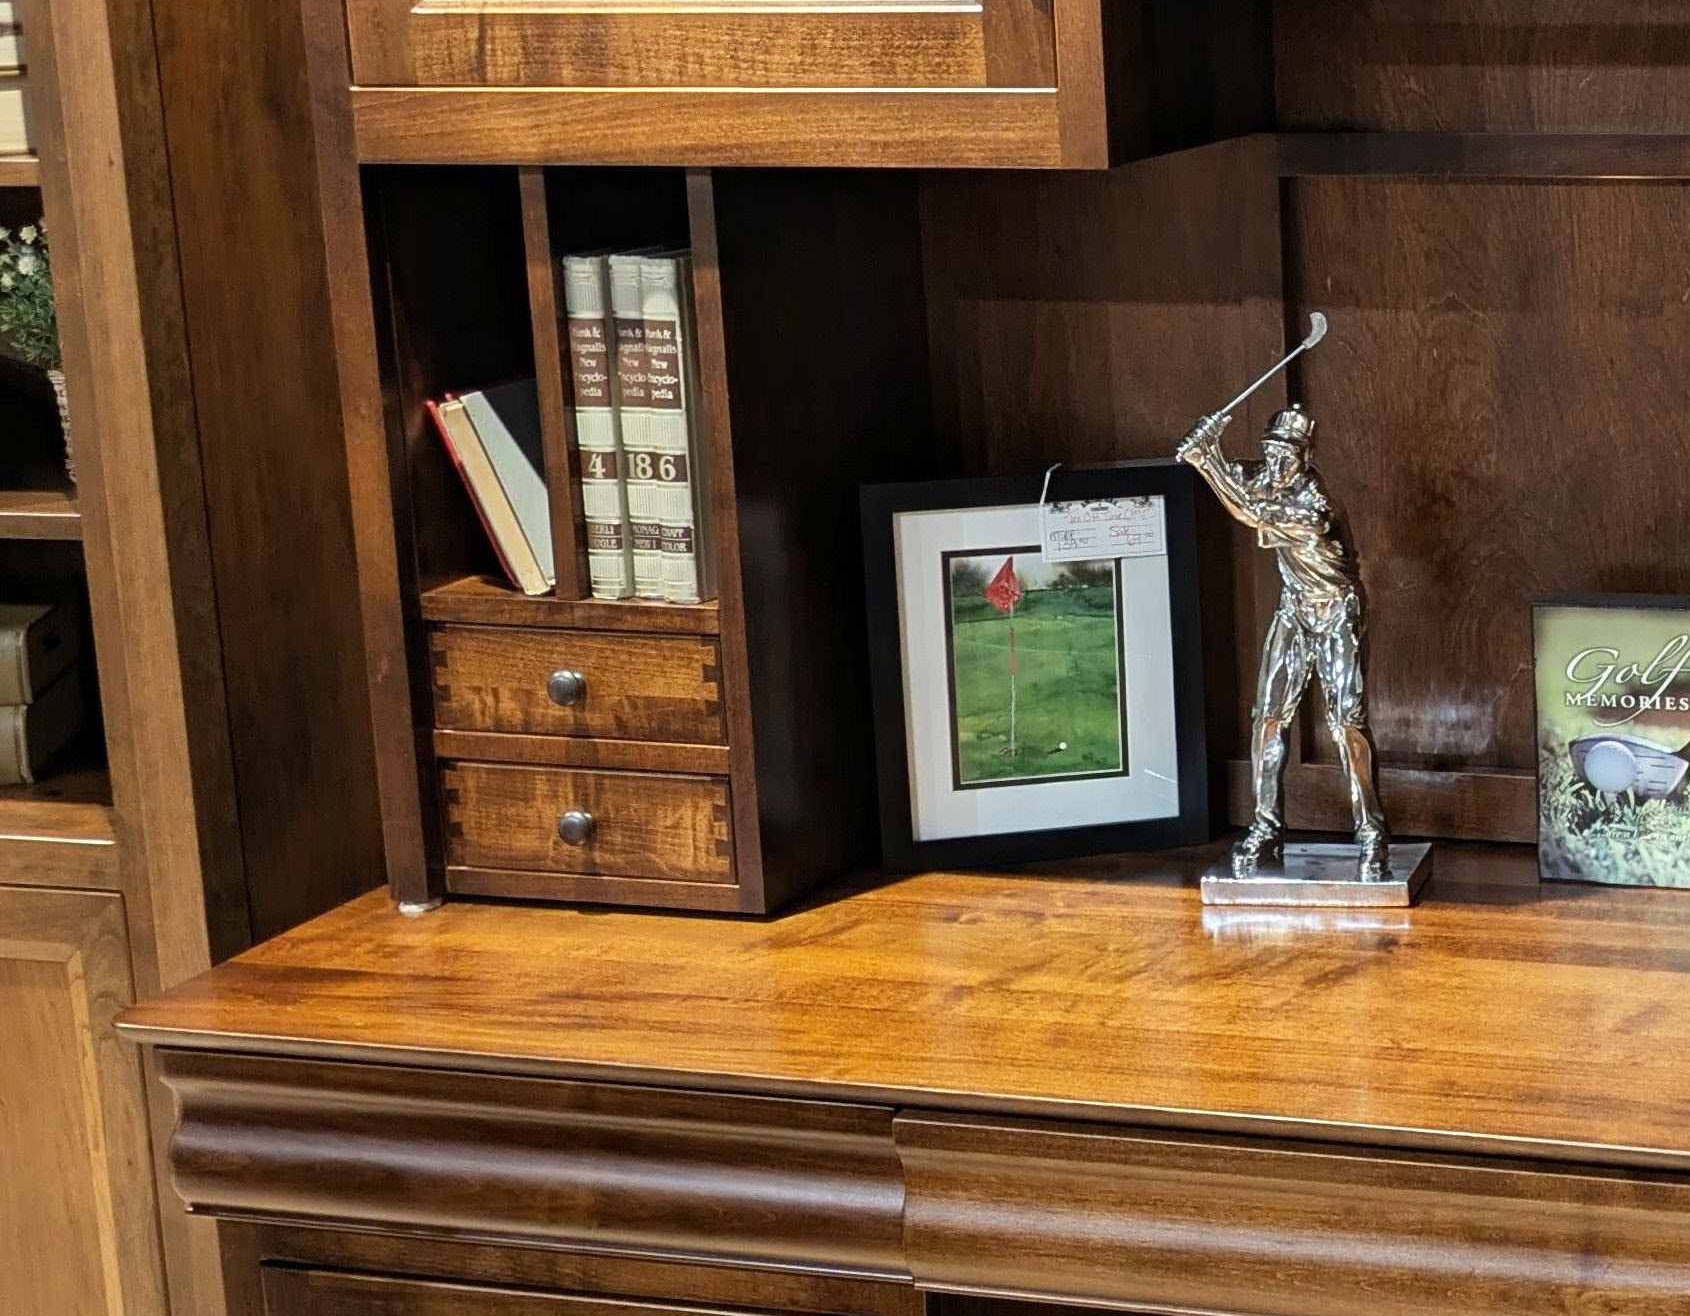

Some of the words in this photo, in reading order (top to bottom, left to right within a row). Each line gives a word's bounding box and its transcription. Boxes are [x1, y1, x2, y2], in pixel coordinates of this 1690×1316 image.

[588, 453, 607, 478] 4
[627, 453, 653, 479] 18
[659, 456, 677, 480] 6
[1564, 691, 1690, 712] MEMORIES
